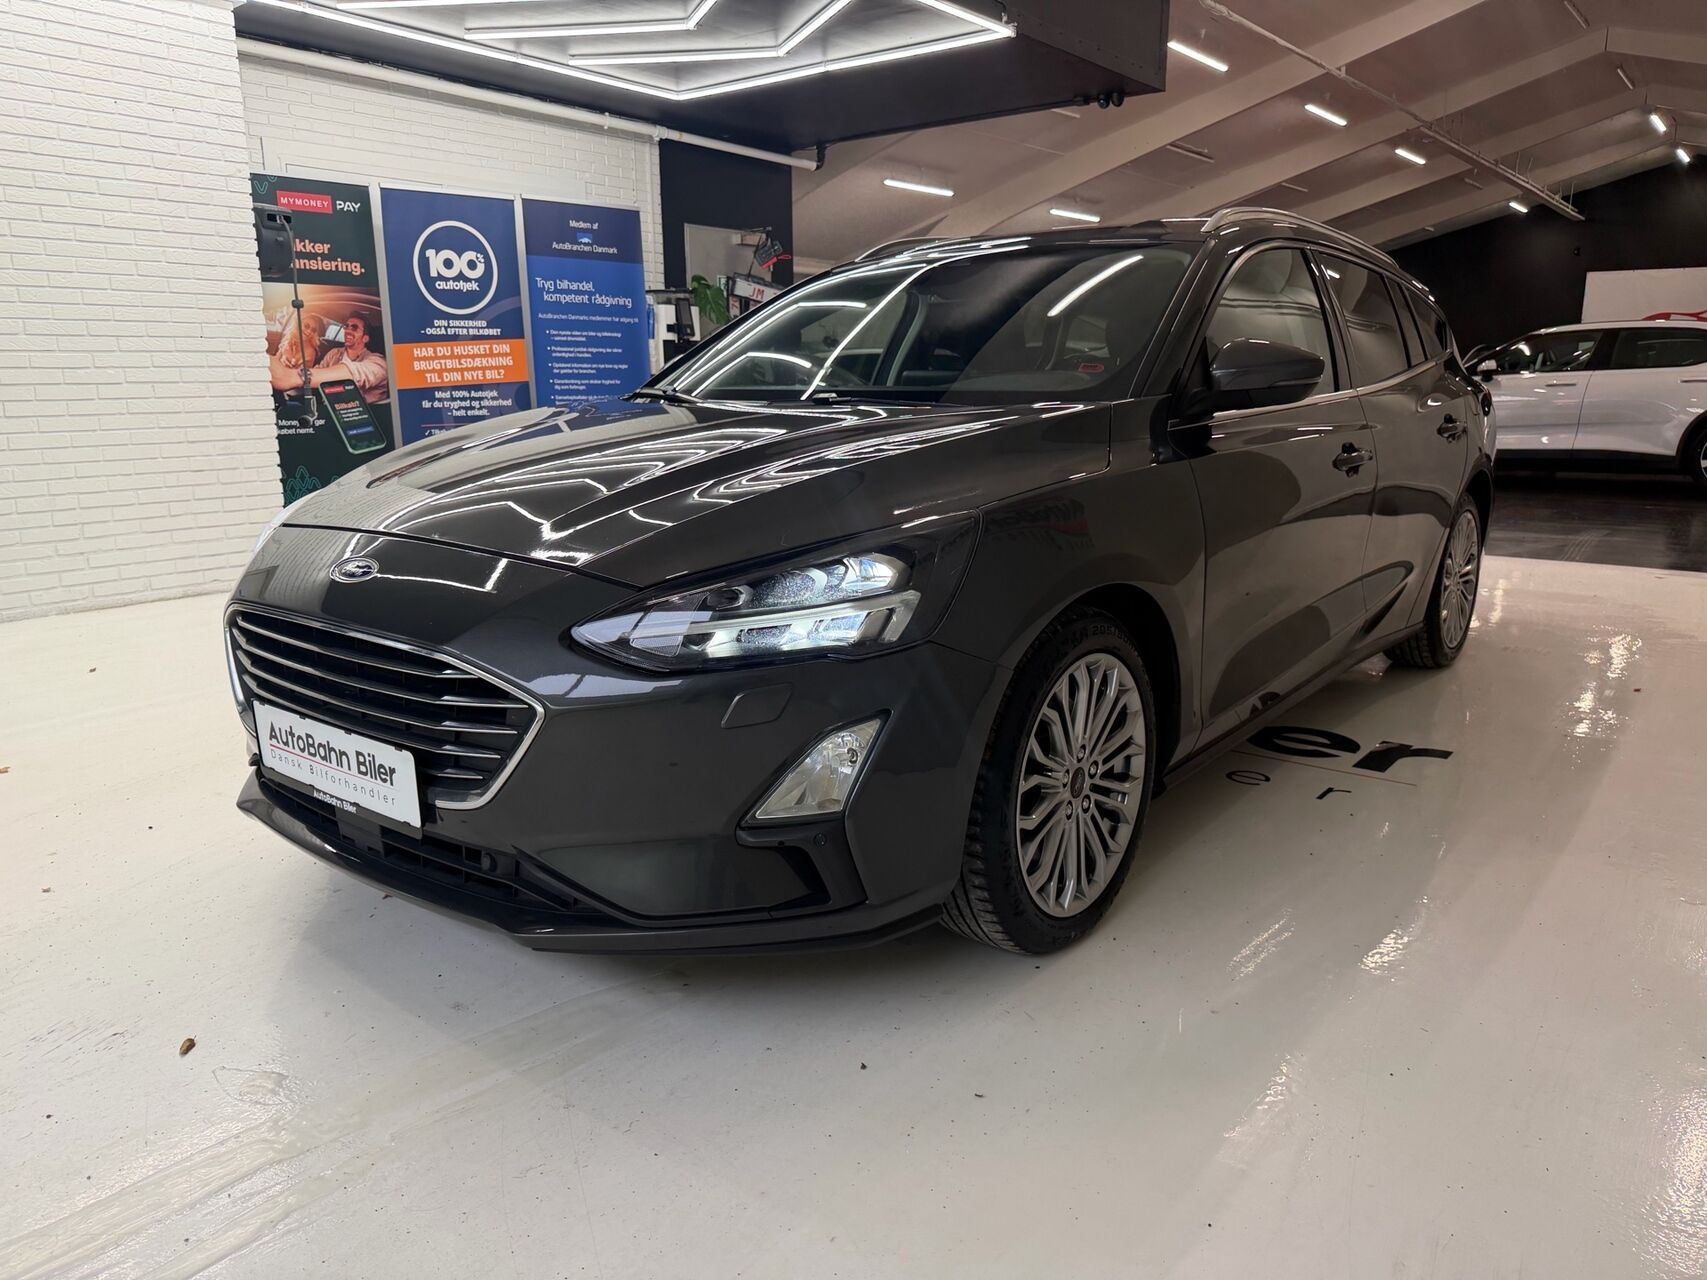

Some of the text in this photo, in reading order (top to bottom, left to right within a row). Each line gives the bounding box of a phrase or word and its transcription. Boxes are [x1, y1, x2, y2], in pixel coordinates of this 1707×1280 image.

[280, 197, 361, 212] MYMONEY PAY
[569, 220, 591, 229] Medlem
[293, 239, 331, 254] kker
[552, 242, 618, 254] AutoBranchen Danmark
[290, 256, 365, 275] ansiering.
[435, 280, 480, 292] autotjek
[536, 277, 595, 292] Tryg bilhandel,
[543, 292, 632, 308] kompetent rådgivning
[426, 326, 446, 335] OGSÅ
[413, 344, 511, 357] HAR DU HUSKET DIN
[413, 356, 513, 371] BRUGTBILSDÆKNING
[425, 369, 505, 383] TIL DIN NYE BIL?
[452, 390, 470, 398] 100%
[470, 390, 499, 399] Autotjek
[422, 400, 433, 408] får
[444, 400, 470, 409] tryghed
[471, 400, 480, 408] og
[481, 398, 512, 407] sikkerhed
[269, 721, 397, 786] AutoBahn Biler
[270, 748, 396, 806] Dansk Bilforhandler
[313, 789, 343, 809] AutoBahn
